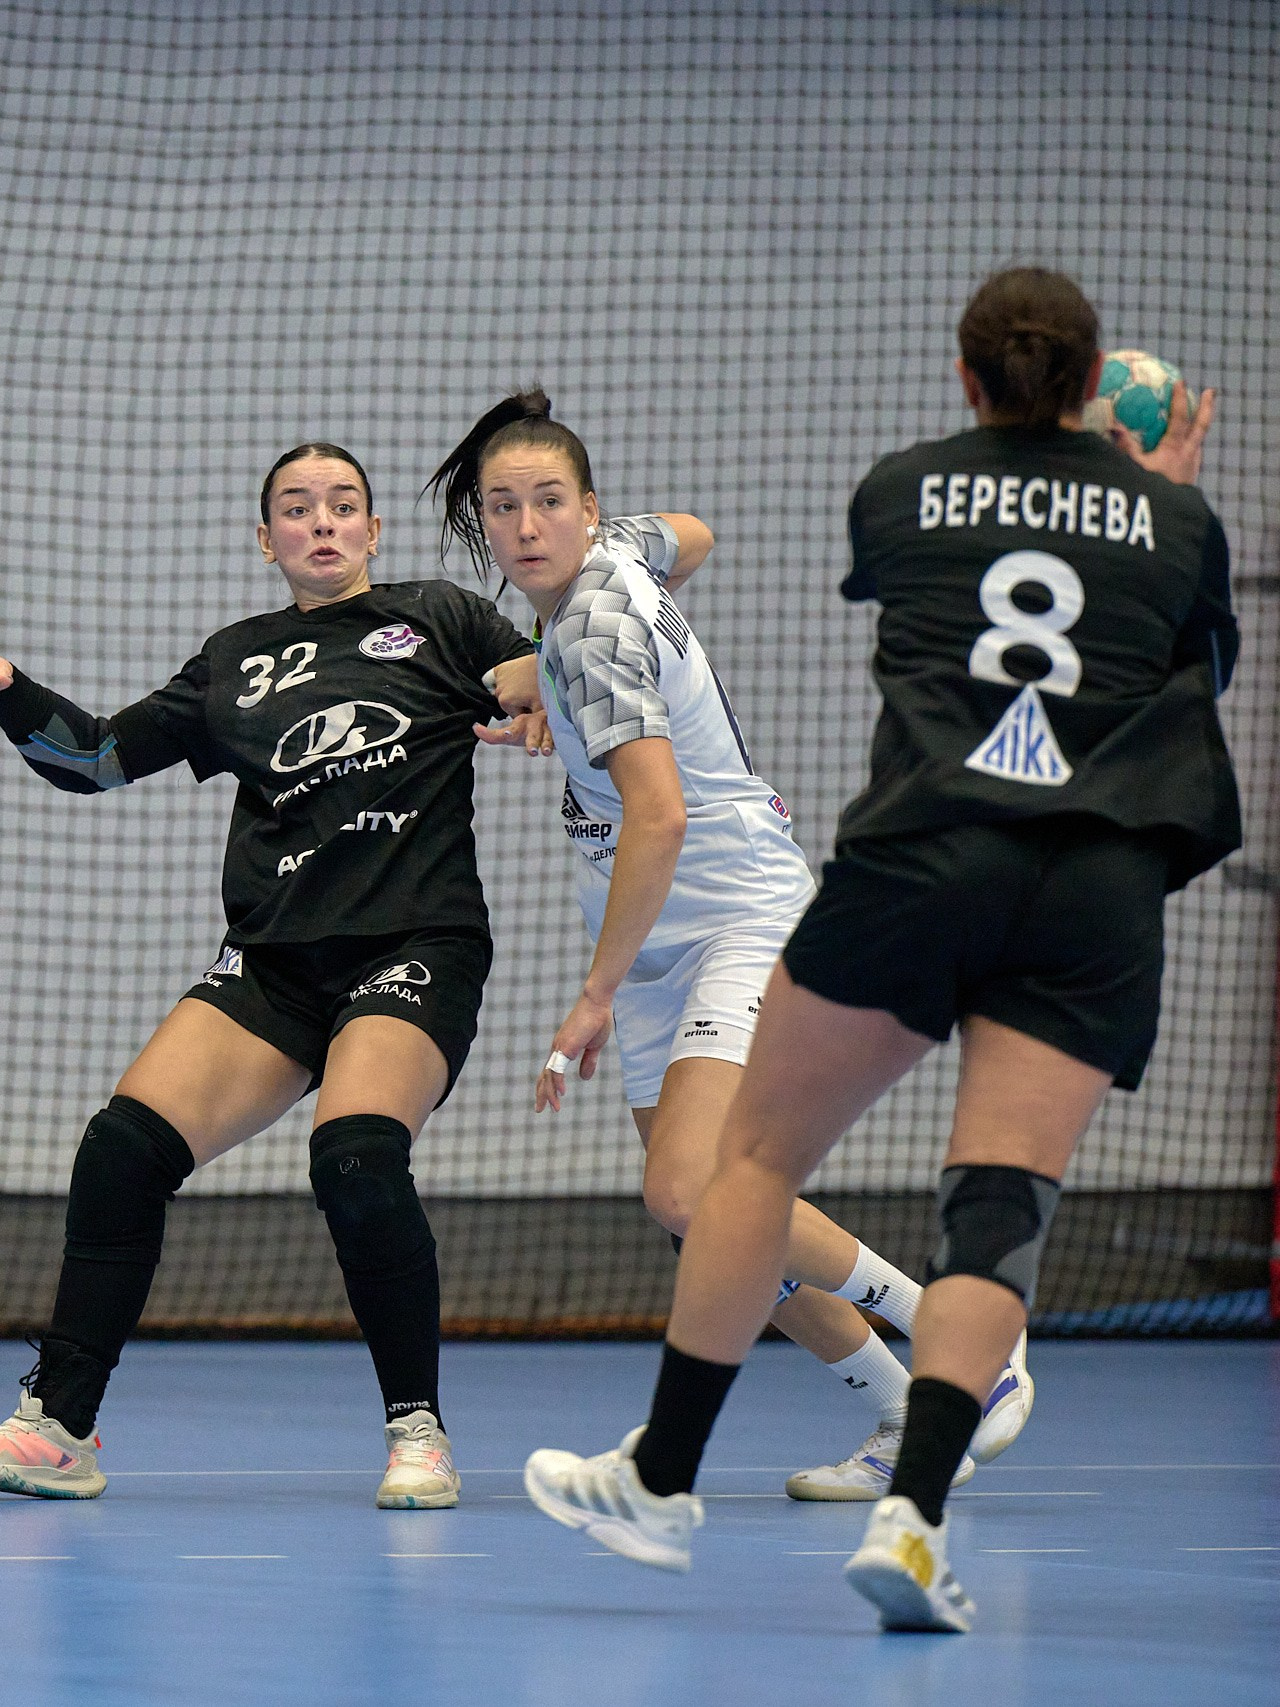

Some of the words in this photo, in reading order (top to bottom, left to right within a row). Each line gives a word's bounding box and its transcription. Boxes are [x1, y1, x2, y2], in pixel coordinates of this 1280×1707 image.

[919, 473, 1156, 552] БЕРЕСНЕВА
[969, 550, 1085, 698] 8
[236, 642, 318, 709] 32
[684, 1028, 718, 1038] erima
